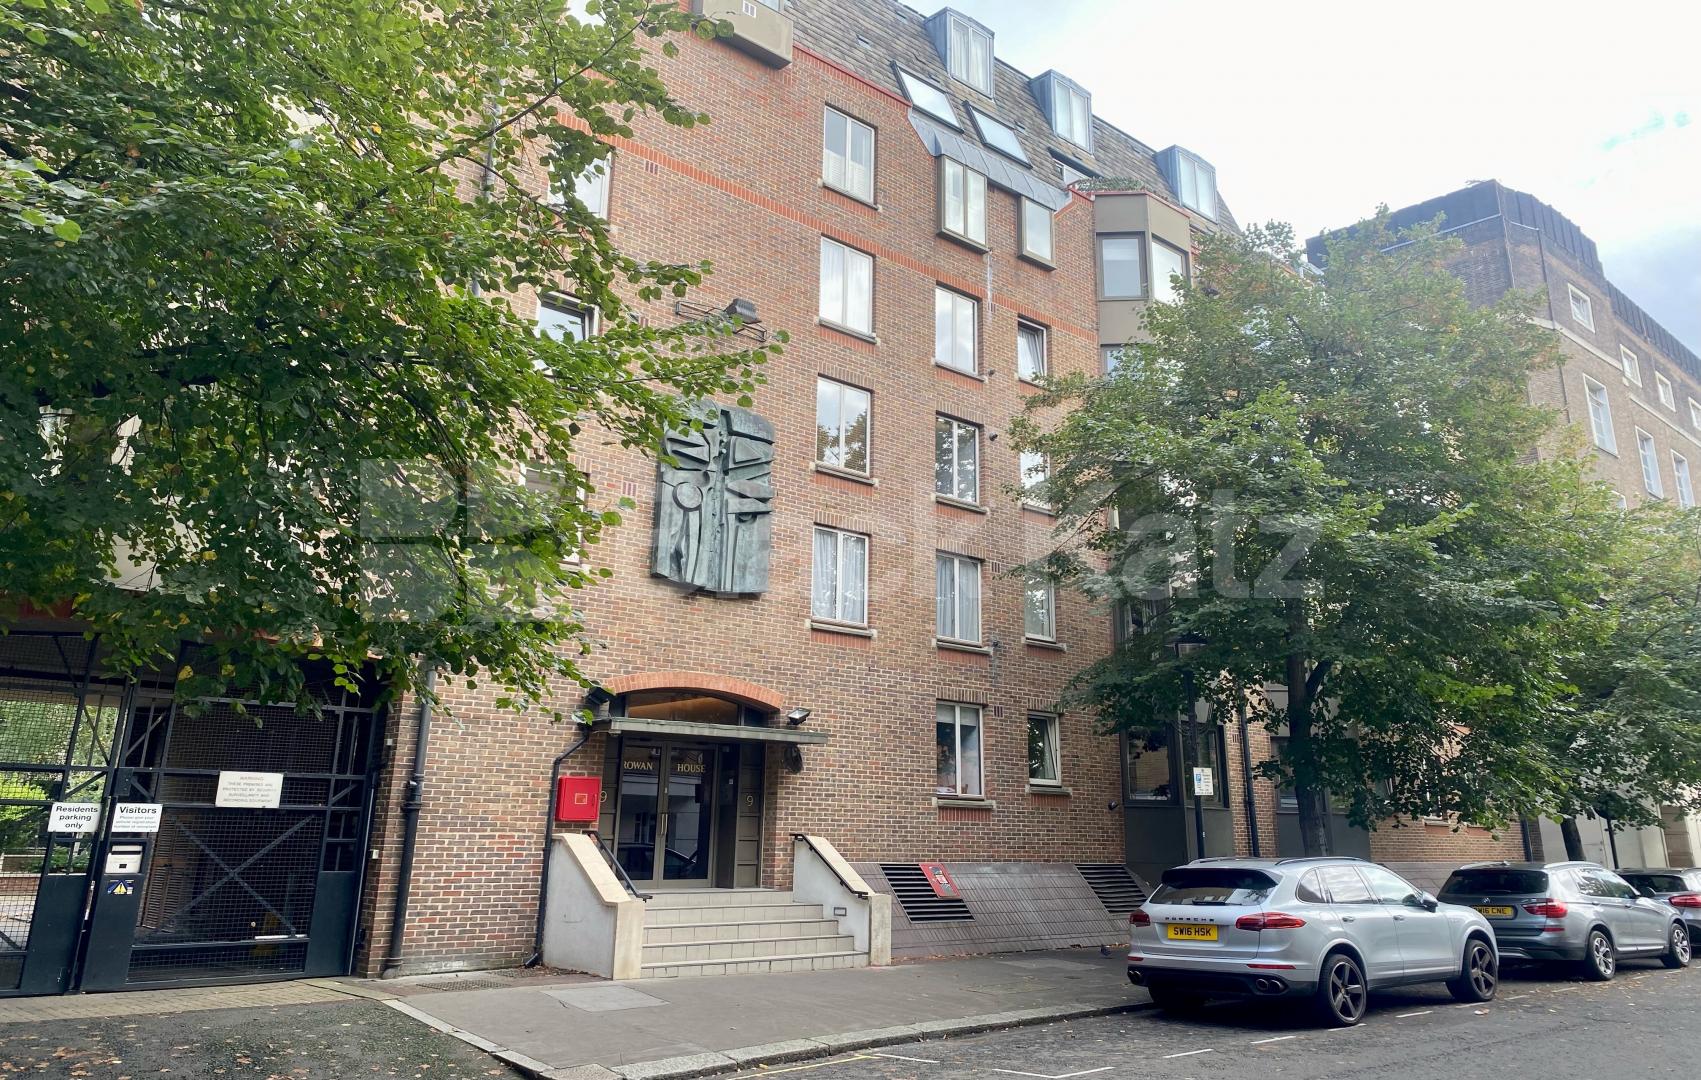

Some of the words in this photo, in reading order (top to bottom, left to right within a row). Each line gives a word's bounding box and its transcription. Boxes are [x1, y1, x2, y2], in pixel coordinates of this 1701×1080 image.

[677, 763, 706, 773] HOUSE
[600, 790, 607, 803] 9
[746, 795, 754, 807] 9
[56, 805, 98, 813] Residents
[120, 806, 157, 814] Visitors
[59, 814, 92, 822] parking
[65, 822, 84, 830] only
[1173, 927, 1192, 936] SW16
[1194, 927, 1212, 937] HSK
